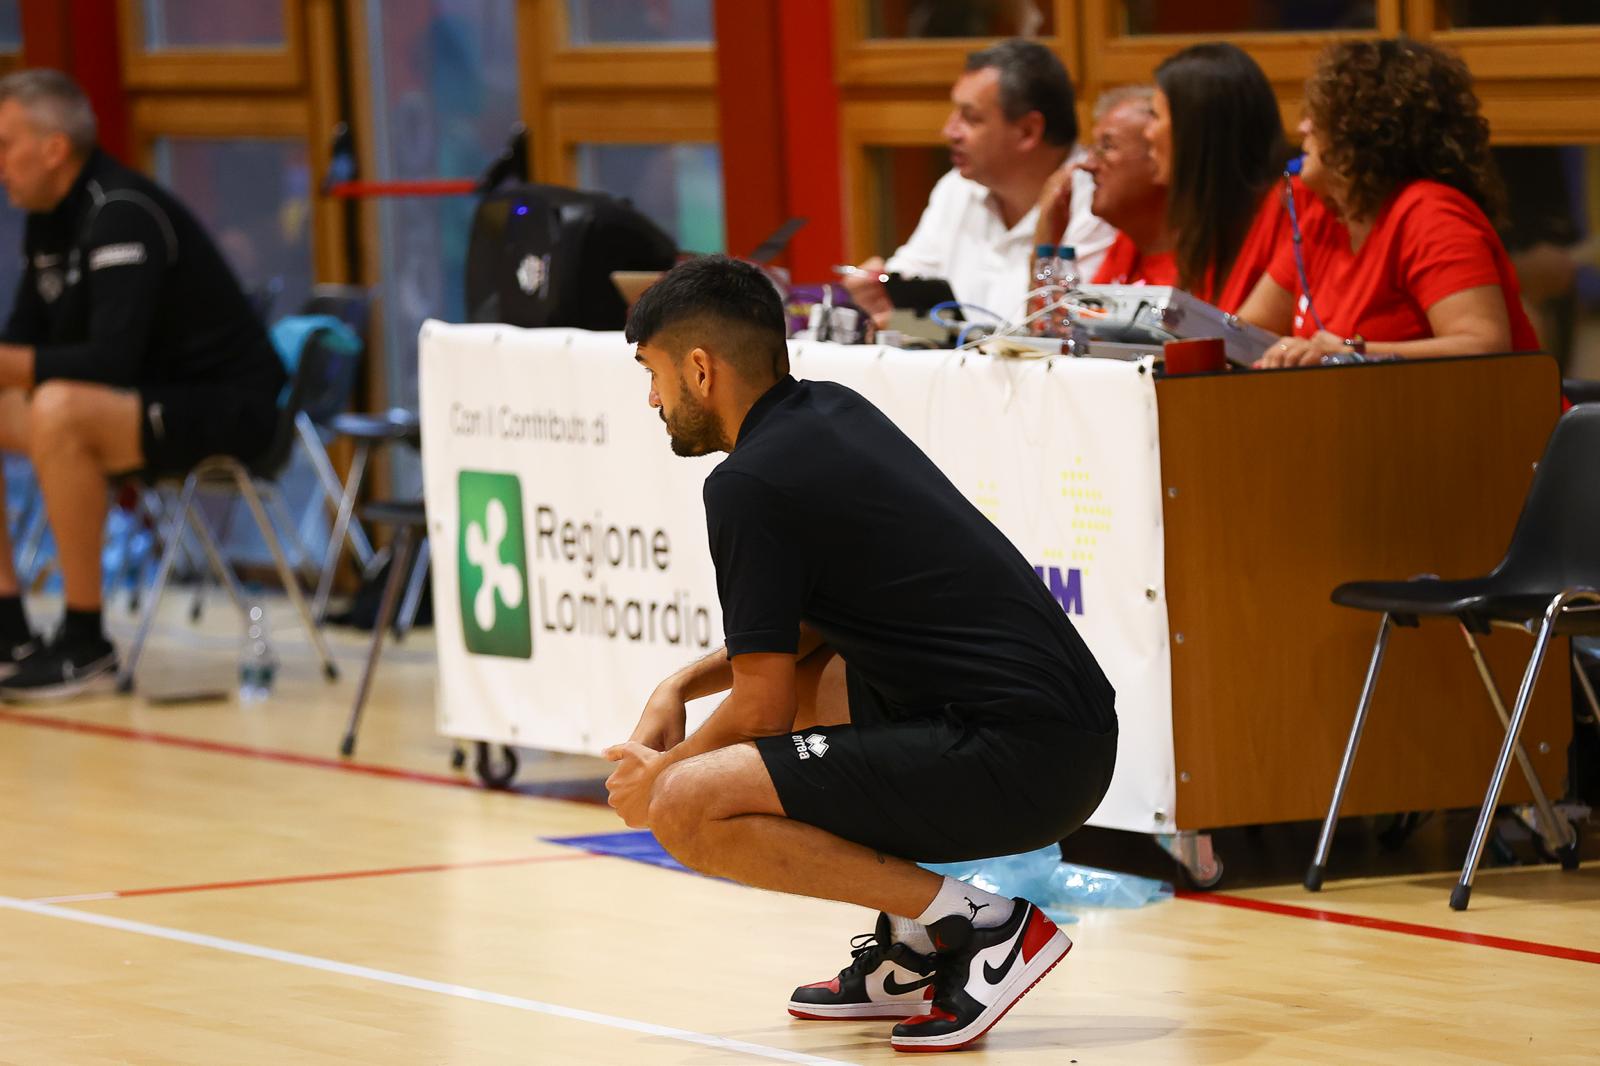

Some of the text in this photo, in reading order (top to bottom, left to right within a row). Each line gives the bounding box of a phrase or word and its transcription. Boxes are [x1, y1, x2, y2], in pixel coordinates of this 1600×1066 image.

[450, 402, 481, 436] Con
[536, 503, 671, 579] Regione
[540, 575, 713, 648] Lombardia
